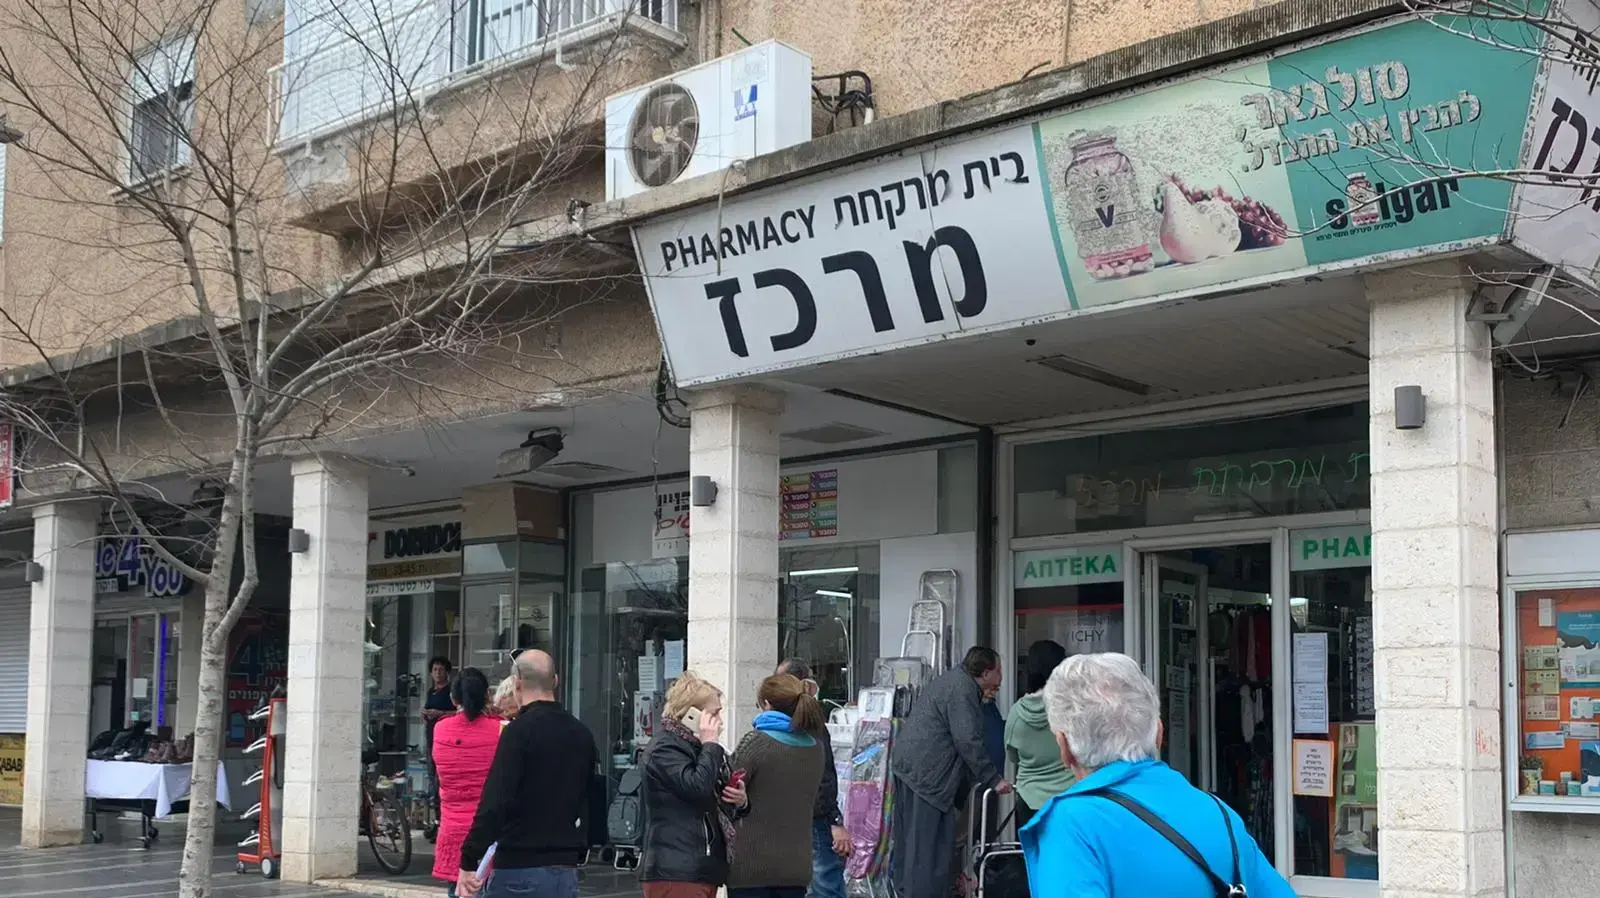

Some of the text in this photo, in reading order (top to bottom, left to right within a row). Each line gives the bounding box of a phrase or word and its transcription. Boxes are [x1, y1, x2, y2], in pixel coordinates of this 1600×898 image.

[1350, 113, 1393, 150] את
[1398, 89, 1482, 144] להבין
[833, 151, 1030, 231] בית מרקחת
[660, 205, 817, 272] PHARMACY
[704, 225, 989, 359] מרכז
[141, 553, 184, 597] You
[1023, 553, 1118, 581] АПТЕКА
